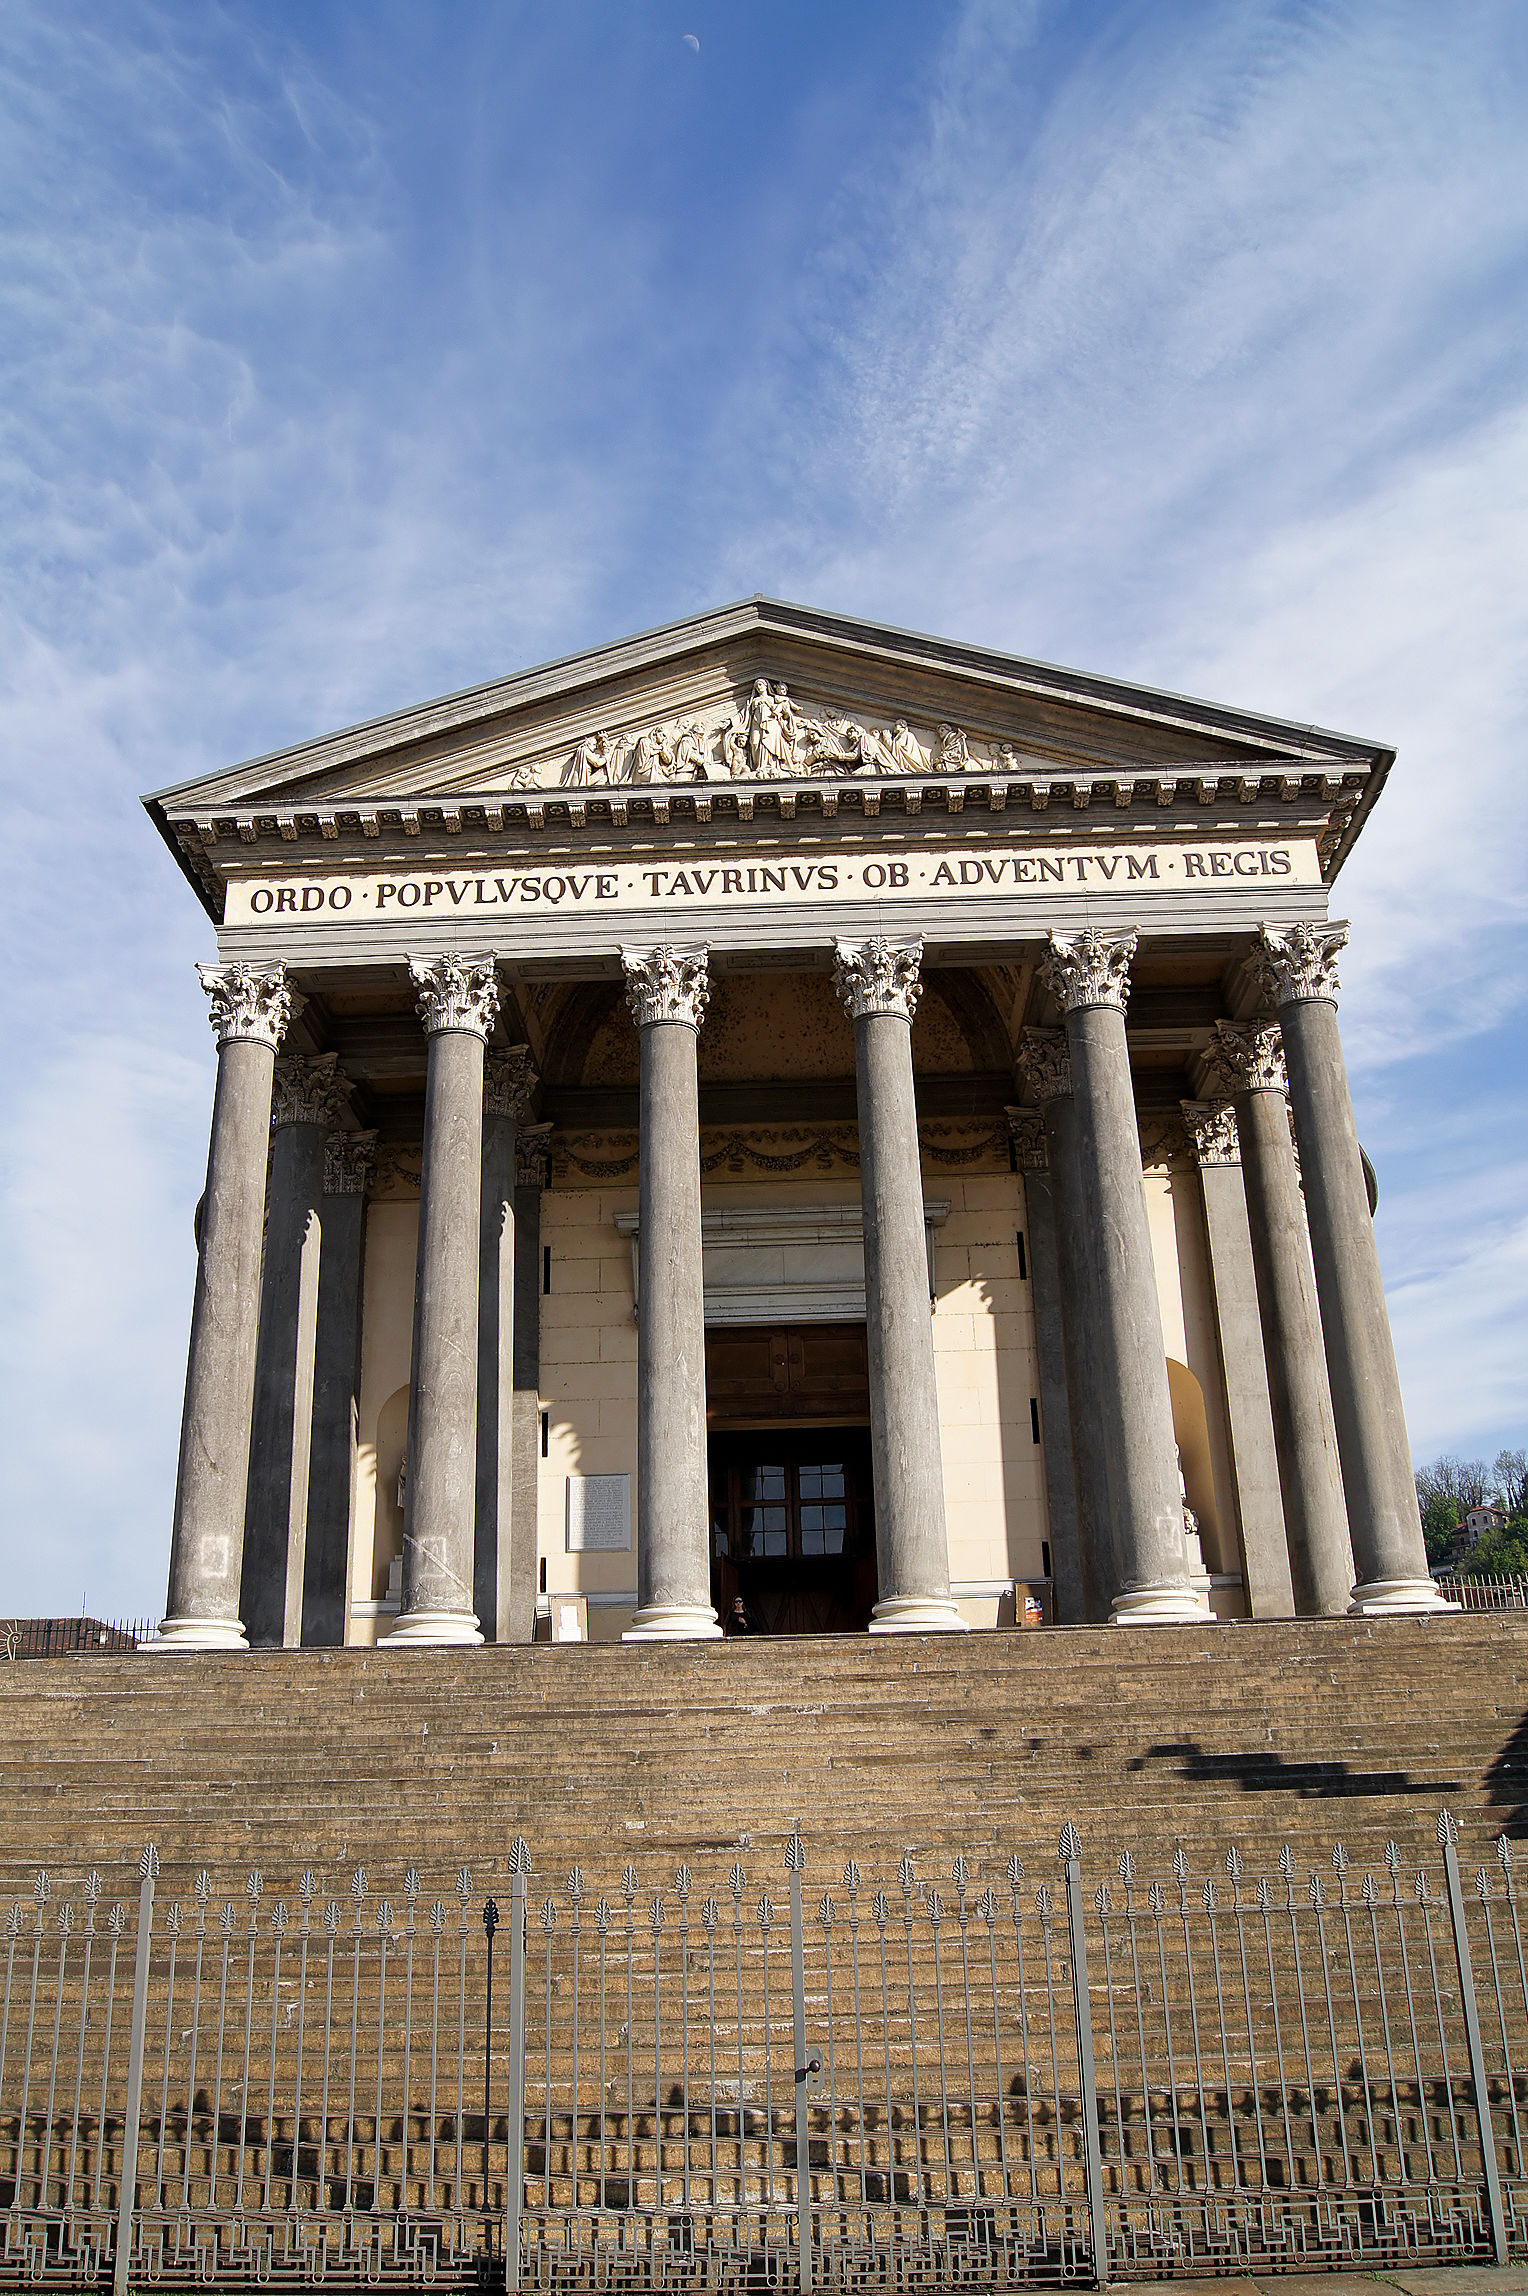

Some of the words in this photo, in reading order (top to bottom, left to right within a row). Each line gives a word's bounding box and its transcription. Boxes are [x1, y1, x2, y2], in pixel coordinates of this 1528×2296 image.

[249, 885, 353, 914] ORDO
[375, 873, 619, 909] POPVLVSQVE
[642, 864, 839, 897] TAVRINVS
[861, 862, 910, 888] OB
[928, 854, 1161, 886] ADVENTVM
[1181, 850, 1292, 878] REGIS
